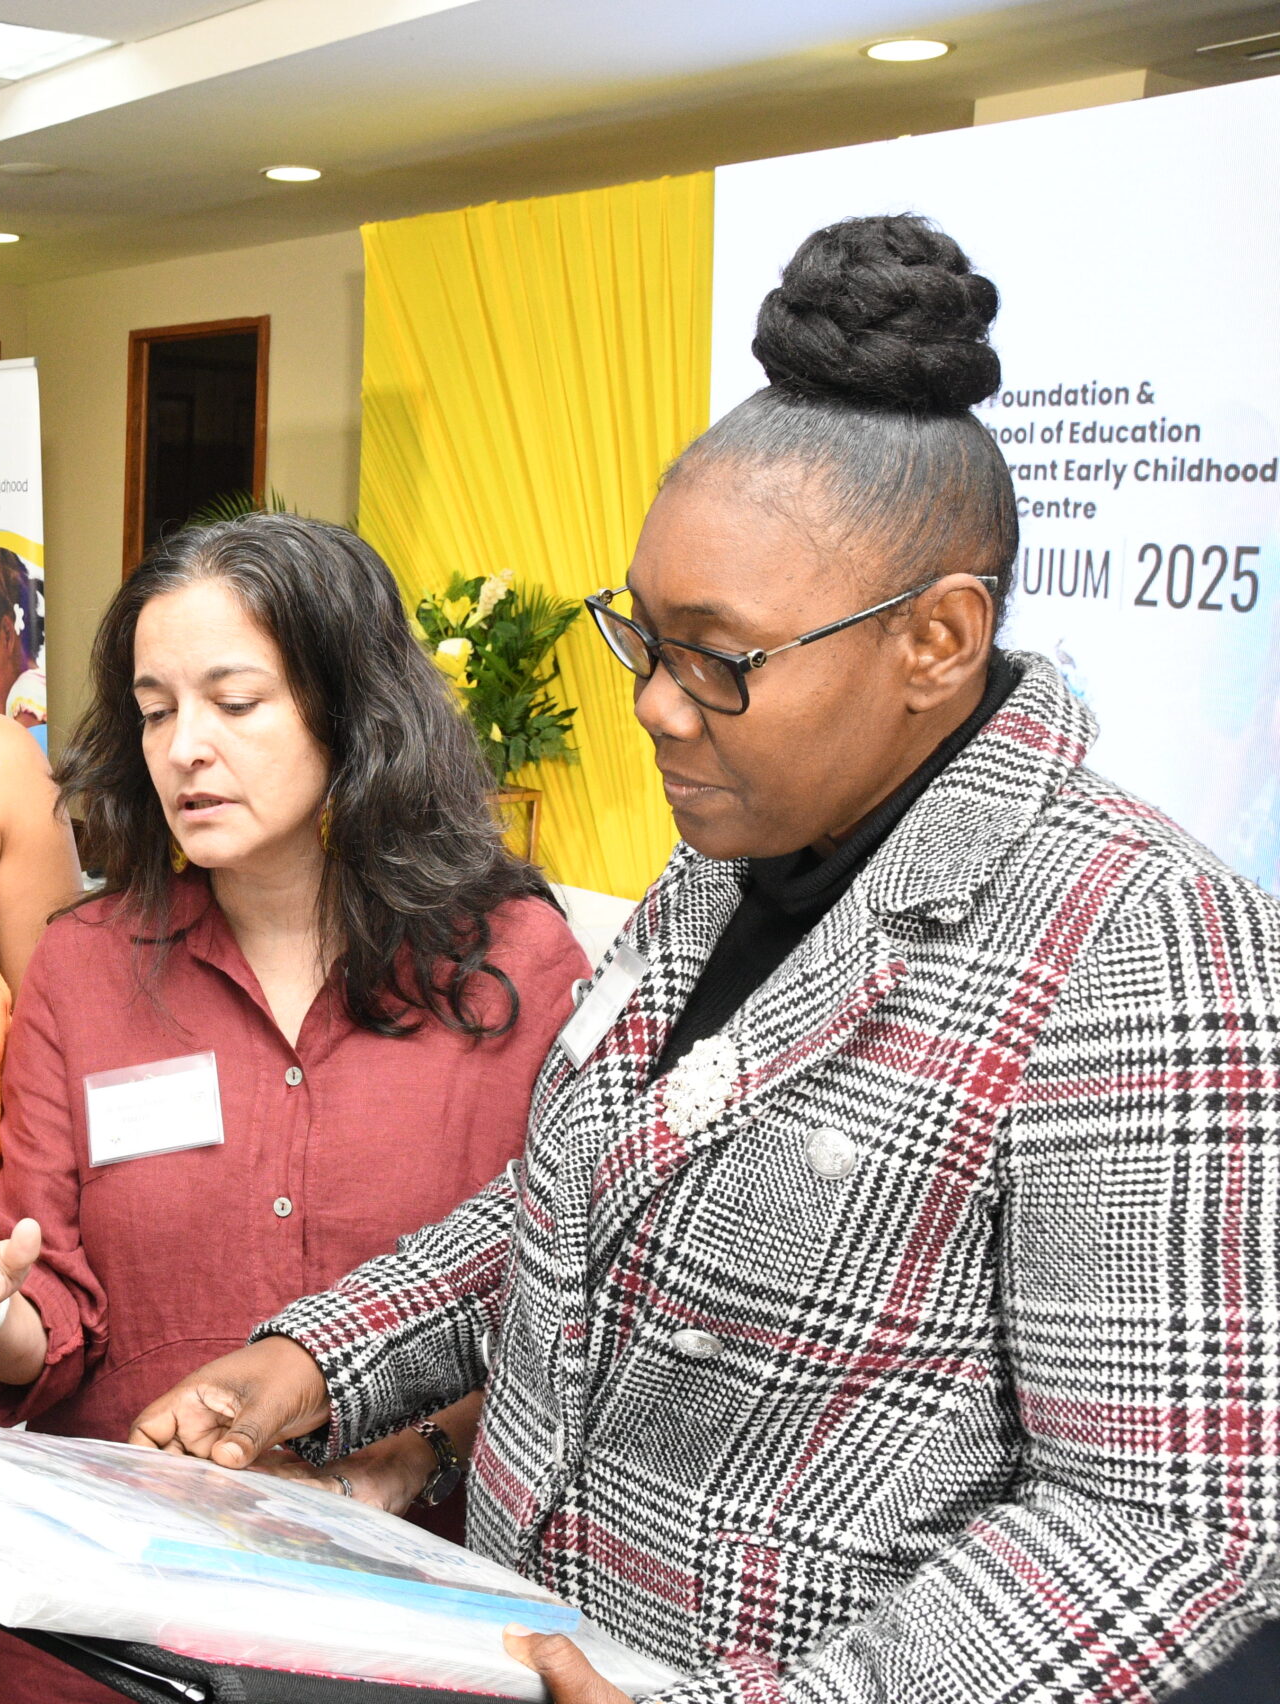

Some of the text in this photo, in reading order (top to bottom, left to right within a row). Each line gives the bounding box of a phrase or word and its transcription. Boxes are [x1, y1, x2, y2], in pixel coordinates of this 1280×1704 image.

[990, 379, 1155, 408] oundation &
[986, 416, 1201, 444] hool of Education
[1008, 455, 1279, 491] rant Early Childhood
[1016, 496, 1098, 520] Centre
[1022, 542, 1260, 613] UIUM 2025
